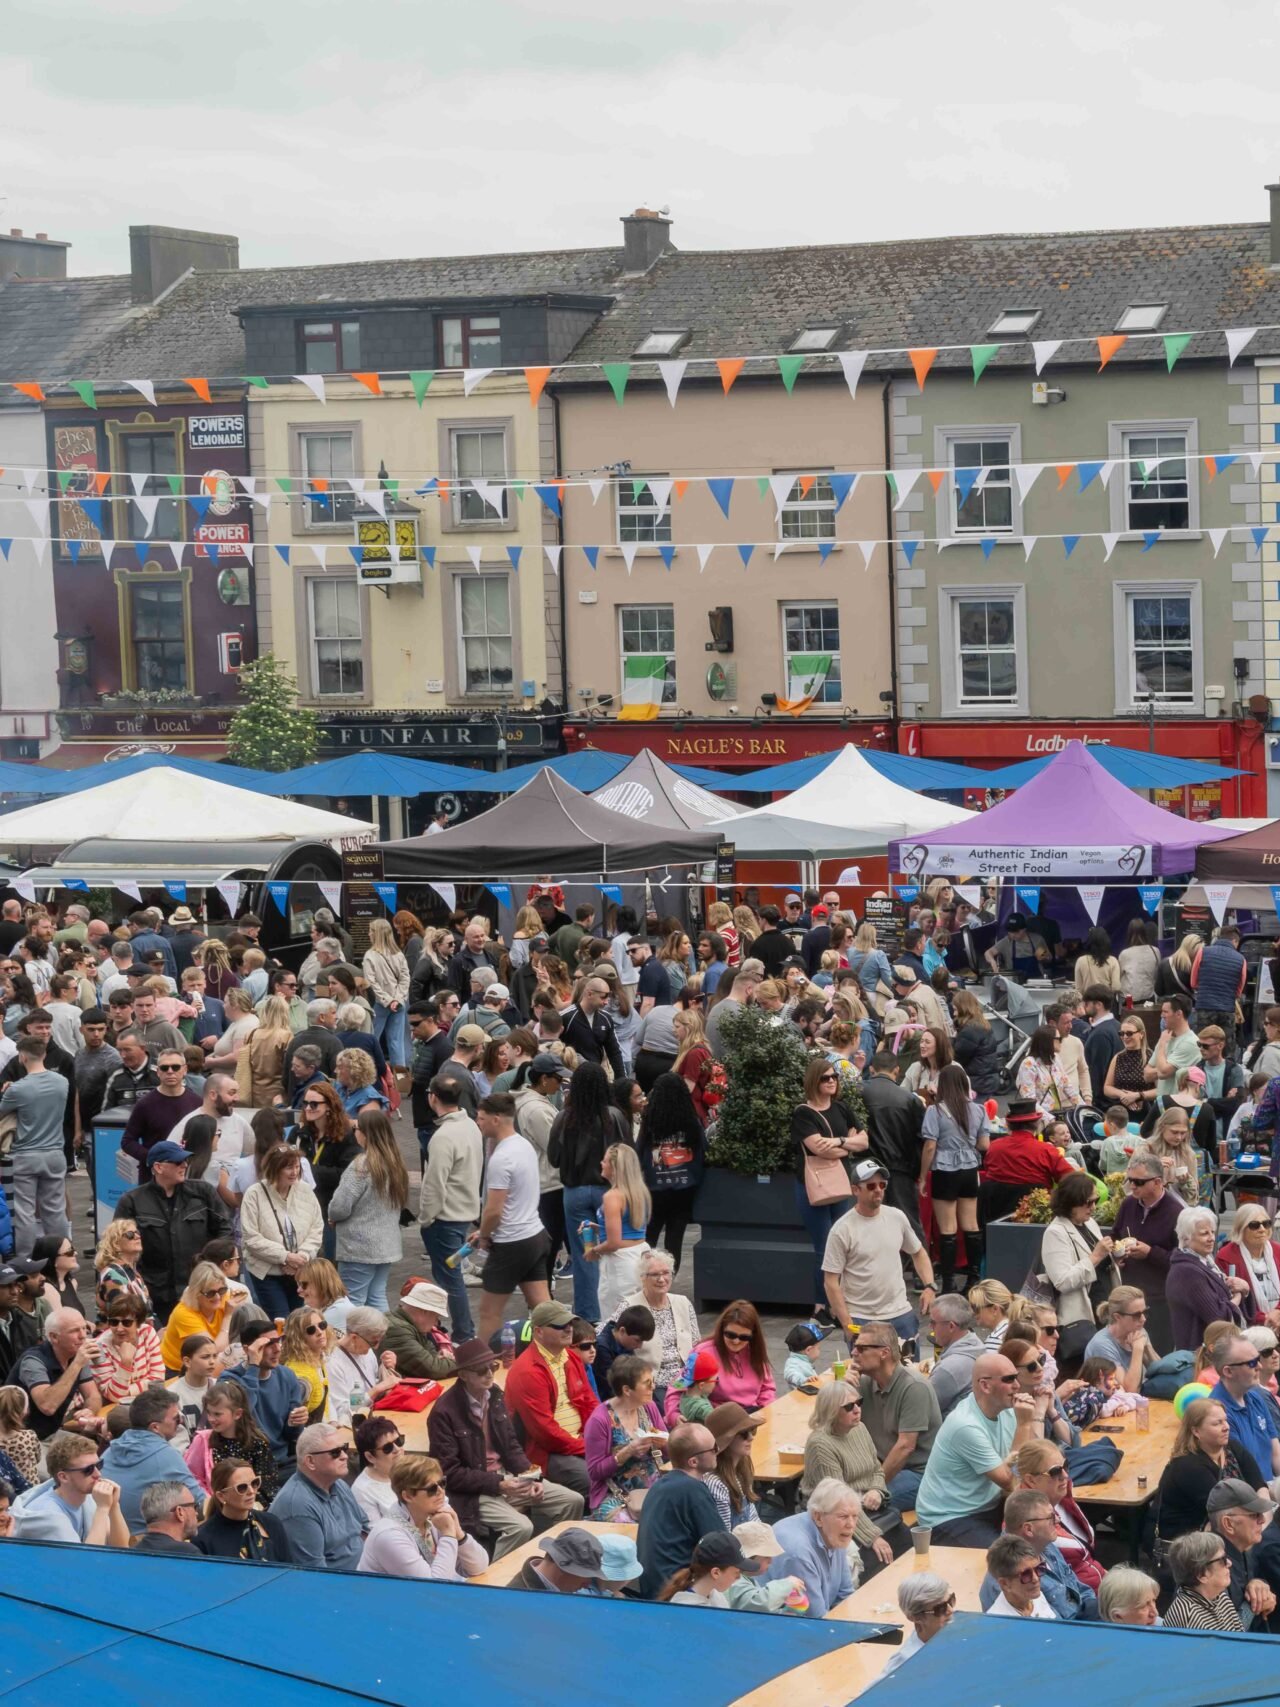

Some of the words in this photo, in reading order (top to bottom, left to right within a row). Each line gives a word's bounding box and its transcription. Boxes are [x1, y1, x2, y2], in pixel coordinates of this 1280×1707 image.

[190, 418, 243, 432] POWERS
[191, 434, 243, 446] LEMONADE
[199, 526, 244, 540] POWER
[341, 728, 472, 744] FUNFAIR
[667, 739, 744, 754] NAGLE'S
[749, 739, 787, 754] BAR
[862, 739, 870, 748] 7
[968, 849, 1018, 859] Authentic
[1030, 848, 1068, 859] Indian
[978, 862, 1019, 873] Street
[1023, 862, 1051, 873] Food
[866, 899, 892, 909] Indian
